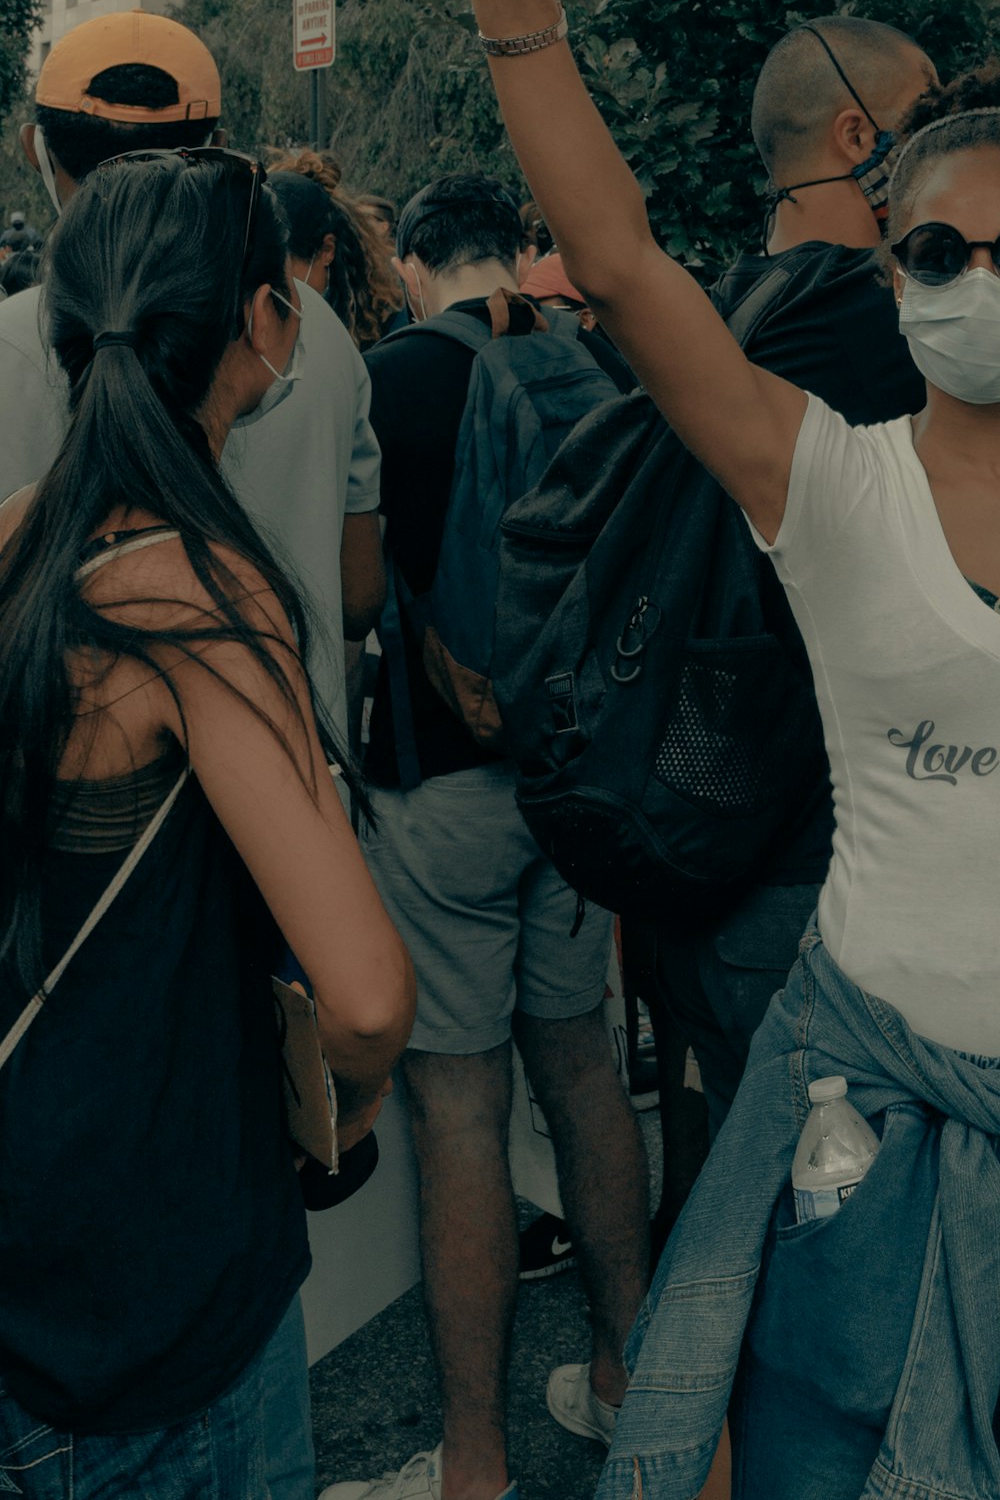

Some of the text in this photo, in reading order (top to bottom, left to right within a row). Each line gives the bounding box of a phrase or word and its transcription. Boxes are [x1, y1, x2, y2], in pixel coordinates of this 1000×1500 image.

[304, 0, 330, 14] PARKING
[302, 15, 328, 30] ANYTIME
[887, 720, 1000, 787] Love
